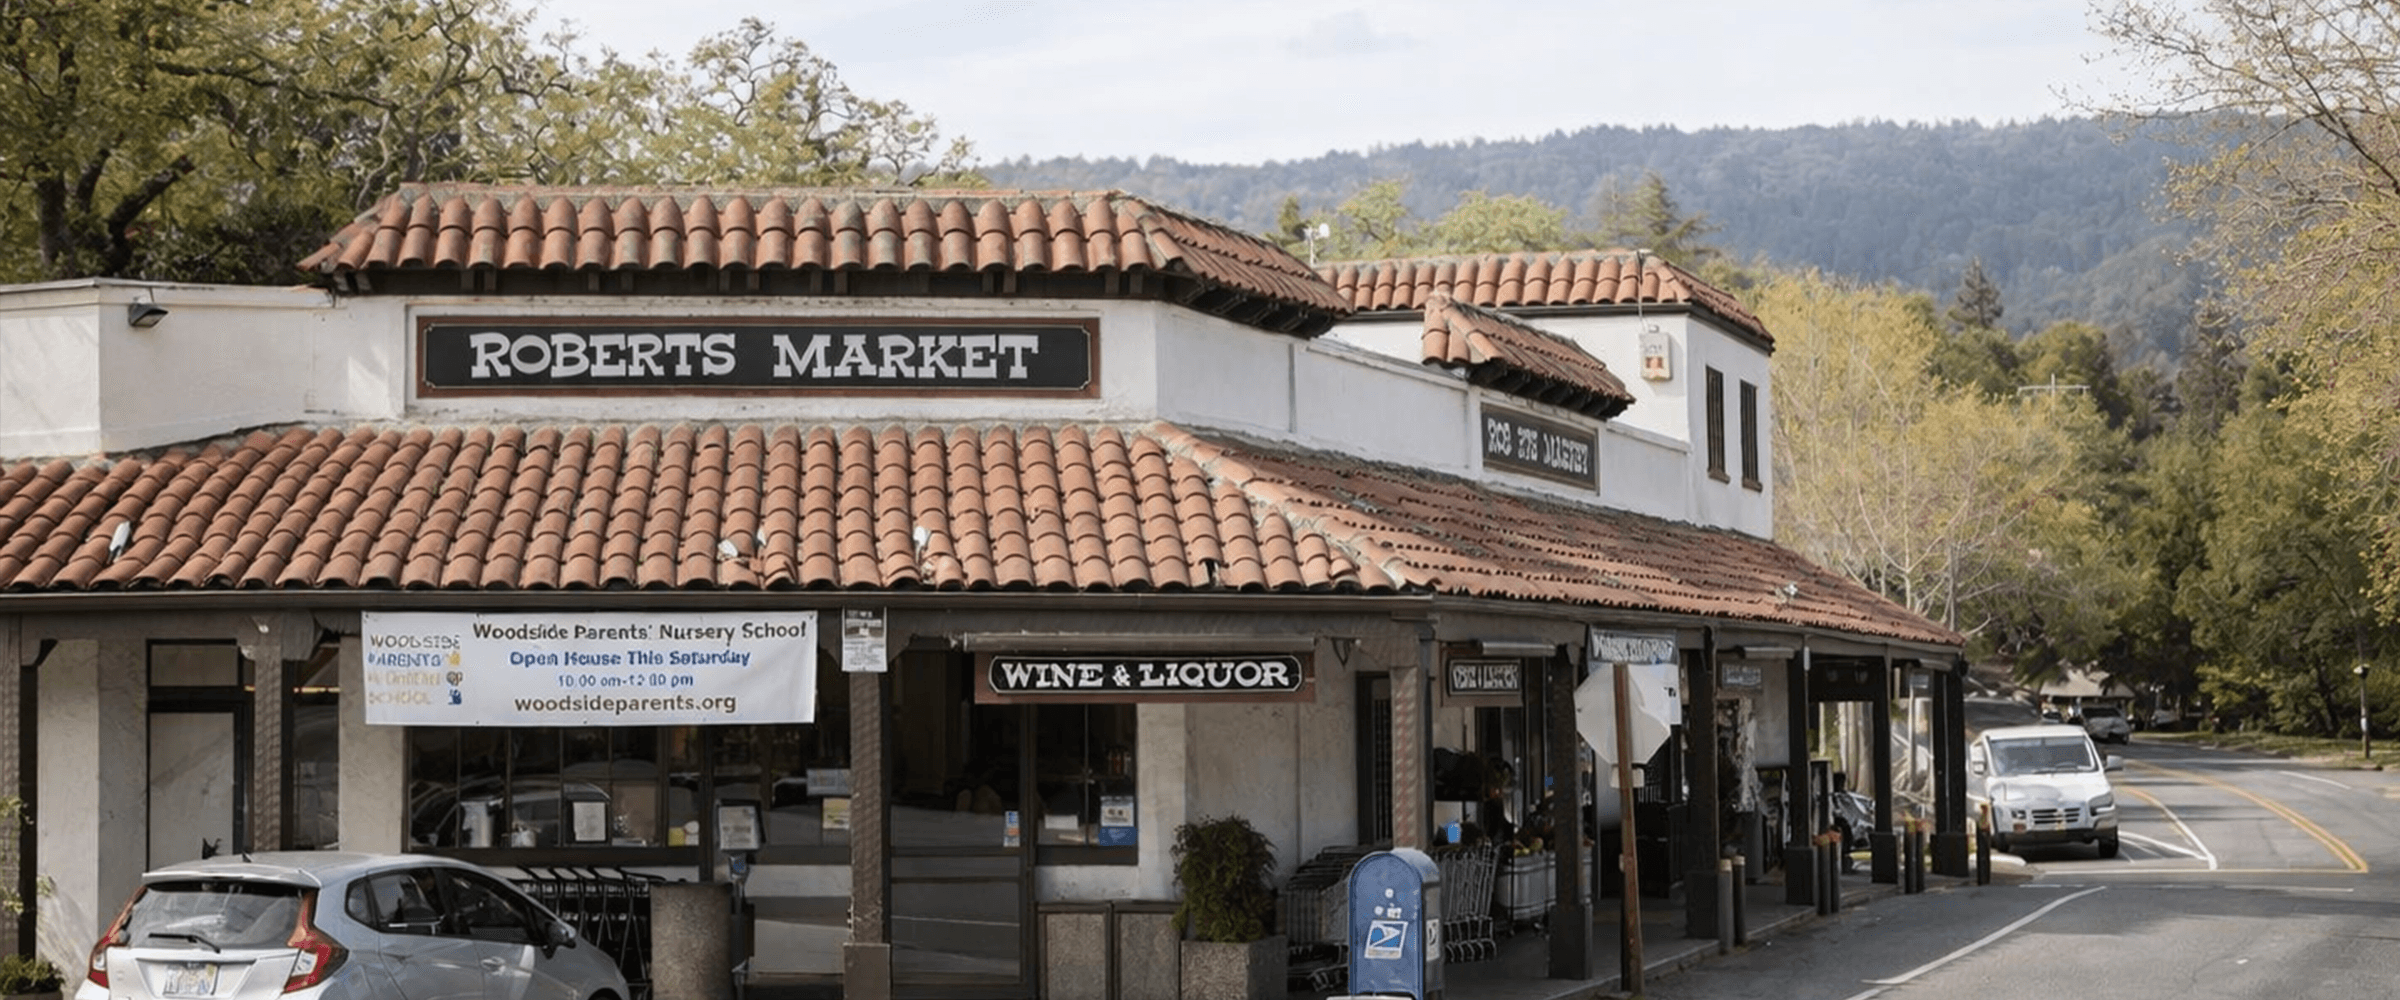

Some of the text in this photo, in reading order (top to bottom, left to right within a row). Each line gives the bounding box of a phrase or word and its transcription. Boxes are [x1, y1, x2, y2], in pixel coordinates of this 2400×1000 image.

[469, 333, 1039, 379] ROBERTS MARKET
[473, 620, 806, 647] Woodside Parents' Nursery School
[510, 650, 752, 668] Open House This Saturday
[559, 674, 597, 688] 1000
[1001, 661, 1290, 688] WINE & LIQUOR
[514, 694, 737, 715] woodsideparents.org
